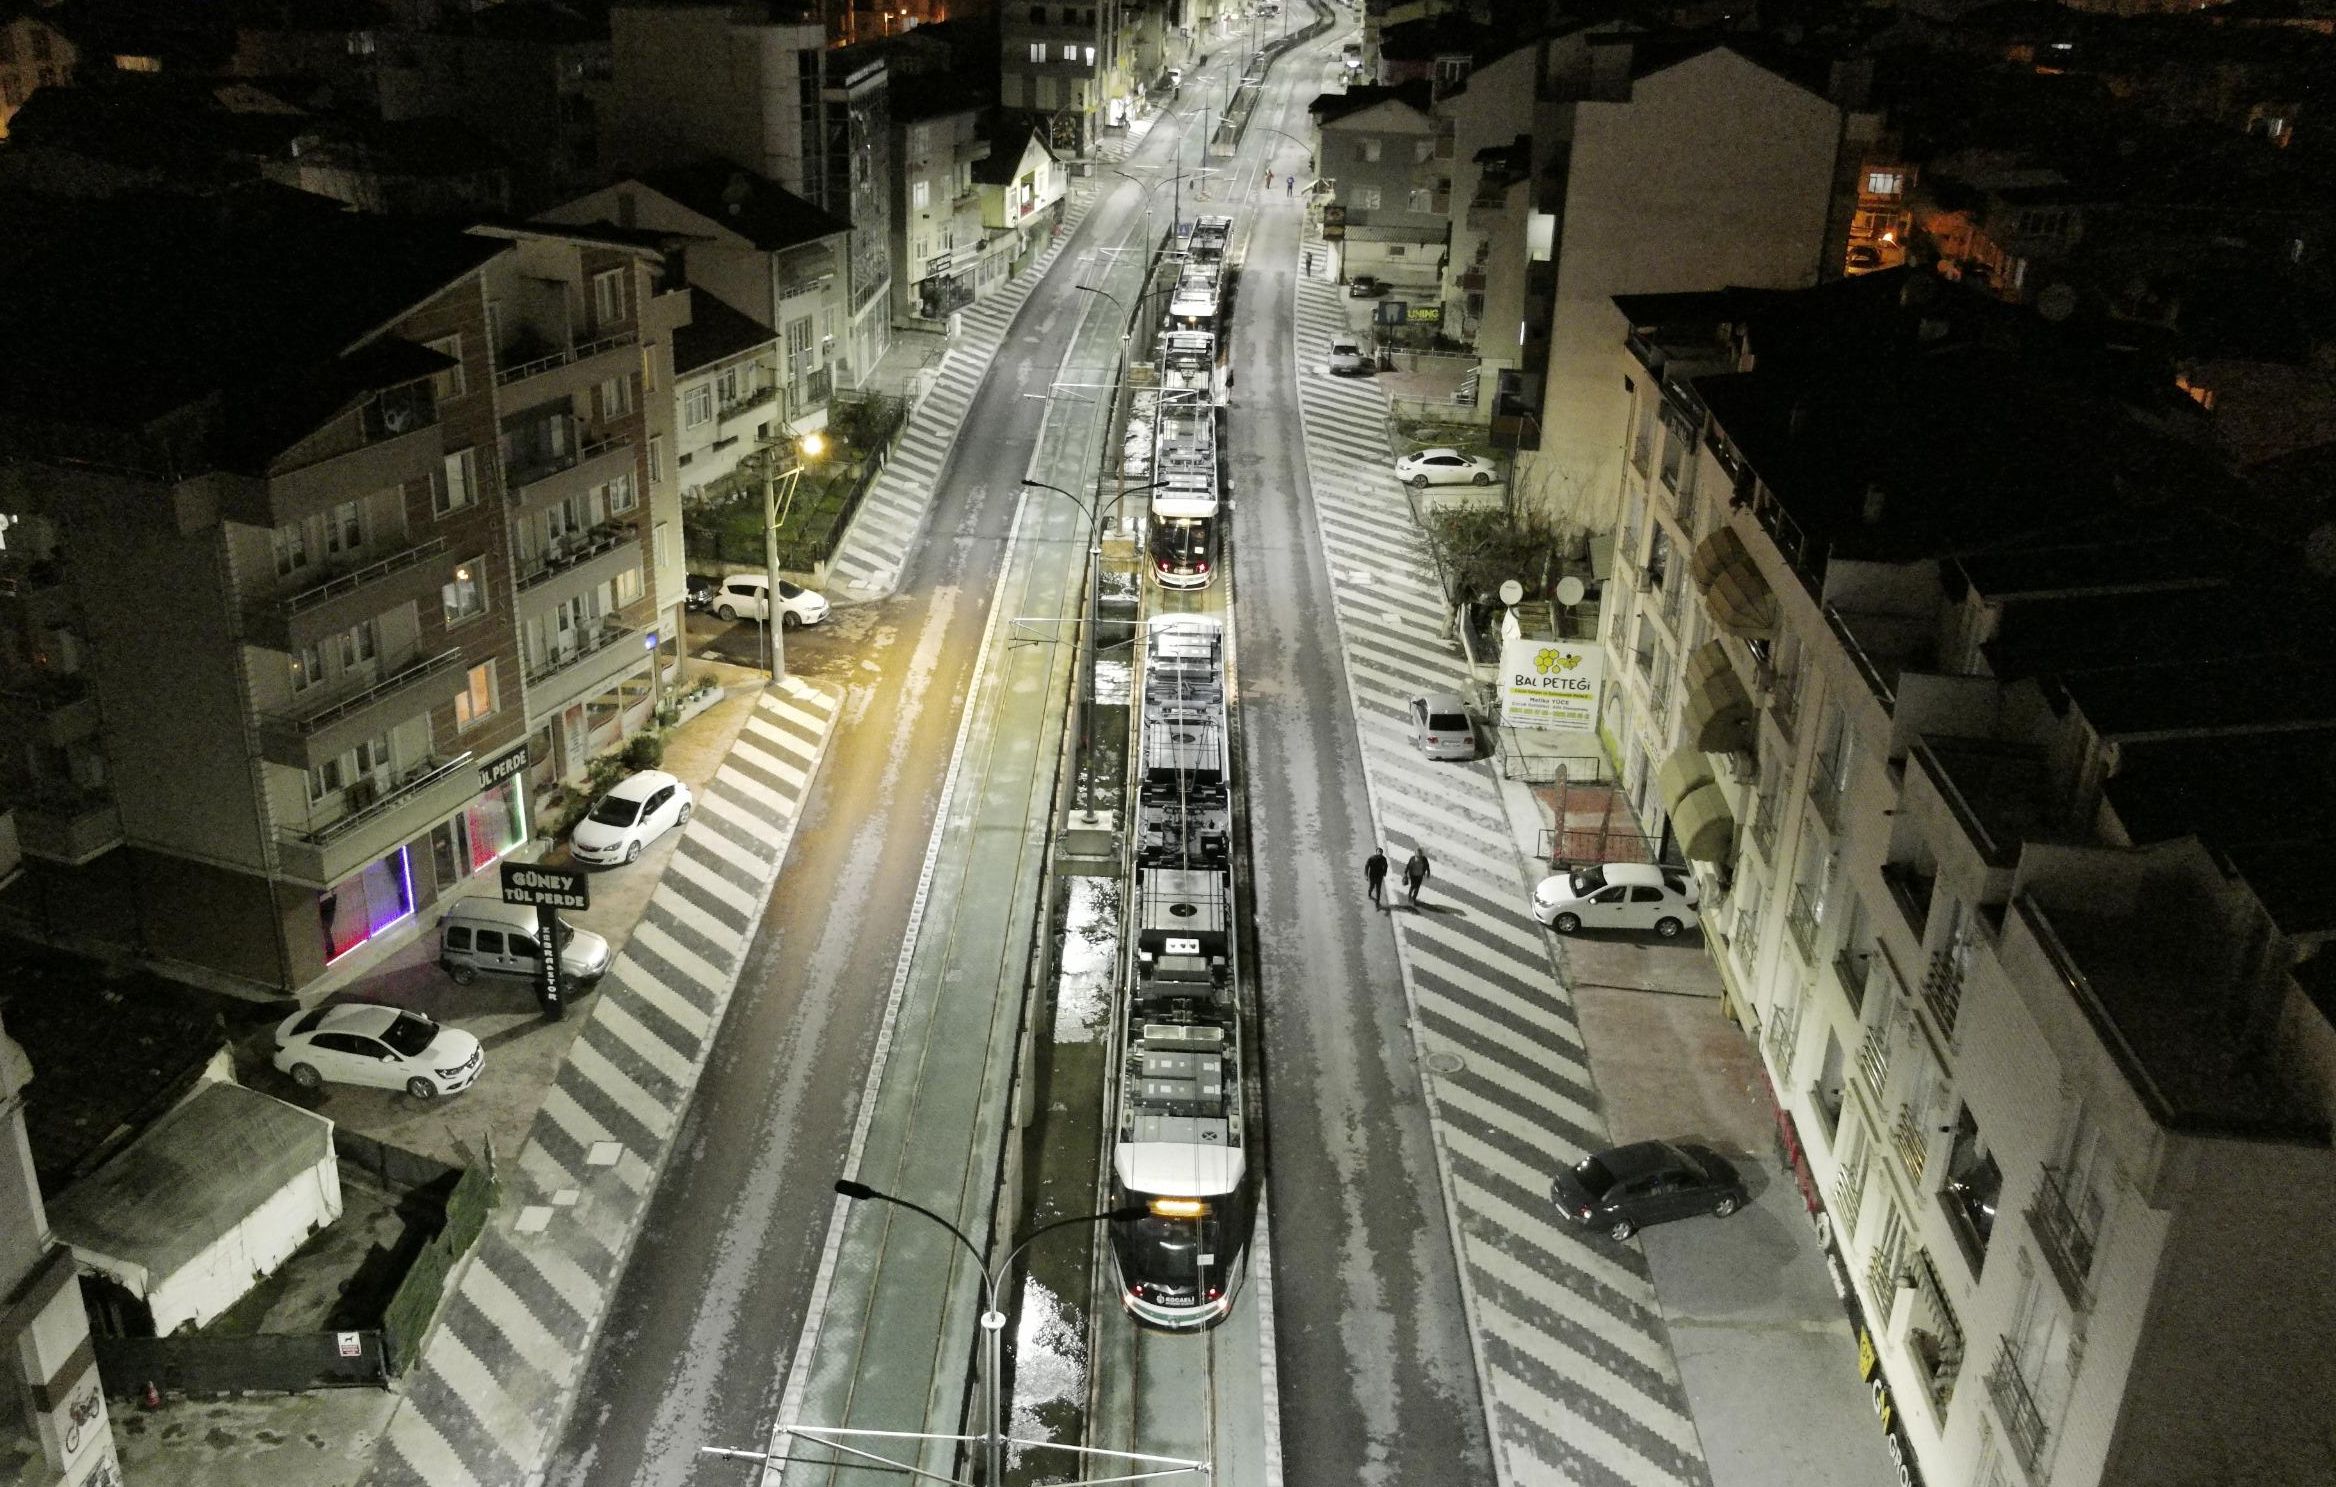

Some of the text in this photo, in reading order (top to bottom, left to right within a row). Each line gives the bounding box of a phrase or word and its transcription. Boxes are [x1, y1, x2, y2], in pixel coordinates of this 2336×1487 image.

[1515, 674, 1537, 687] BAL
[492, 749, 527, 781] PERDE
[512, 871, 574, 891] GÜNEY
[504, 887, 585, 907] TÜL PERDE
[1888, 1432, 1912, 1487] GRO
